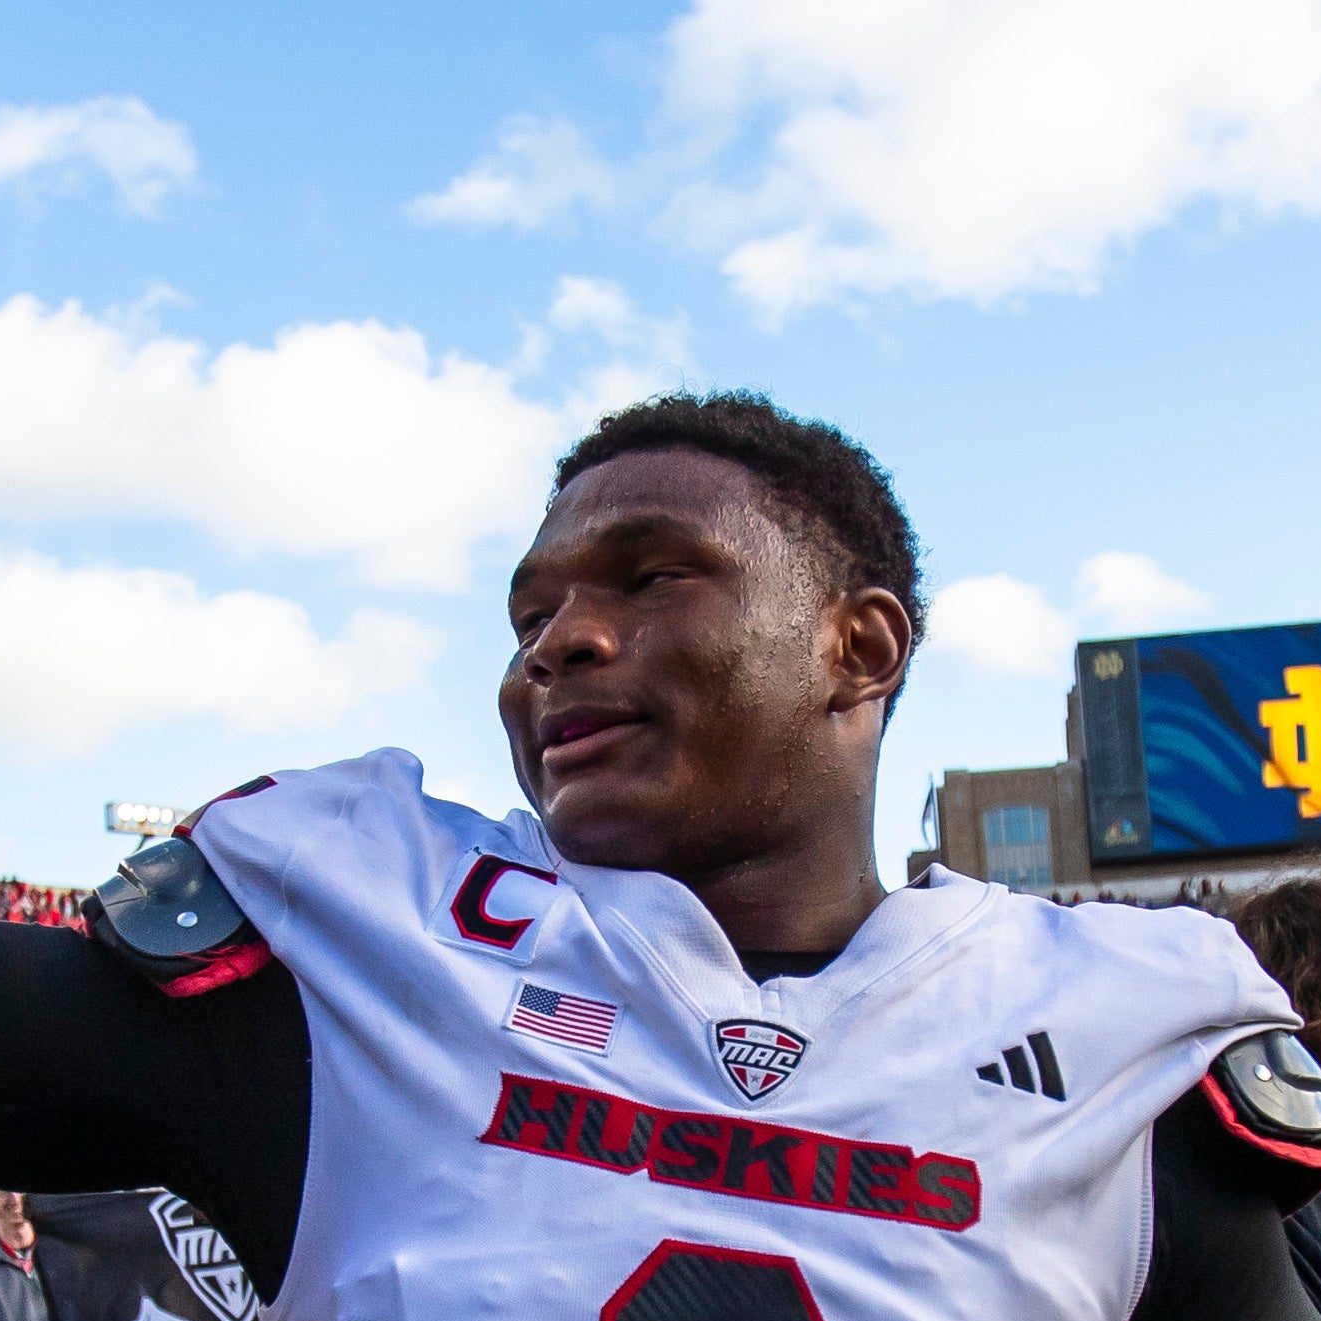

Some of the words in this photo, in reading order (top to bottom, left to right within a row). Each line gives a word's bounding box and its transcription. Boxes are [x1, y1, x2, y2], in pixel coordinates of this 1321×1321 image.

[450, 854, 558, 950] C
[720, 1041, 799, 1073] MAC
[479, 1073, 981, 1232] HUSKIES
